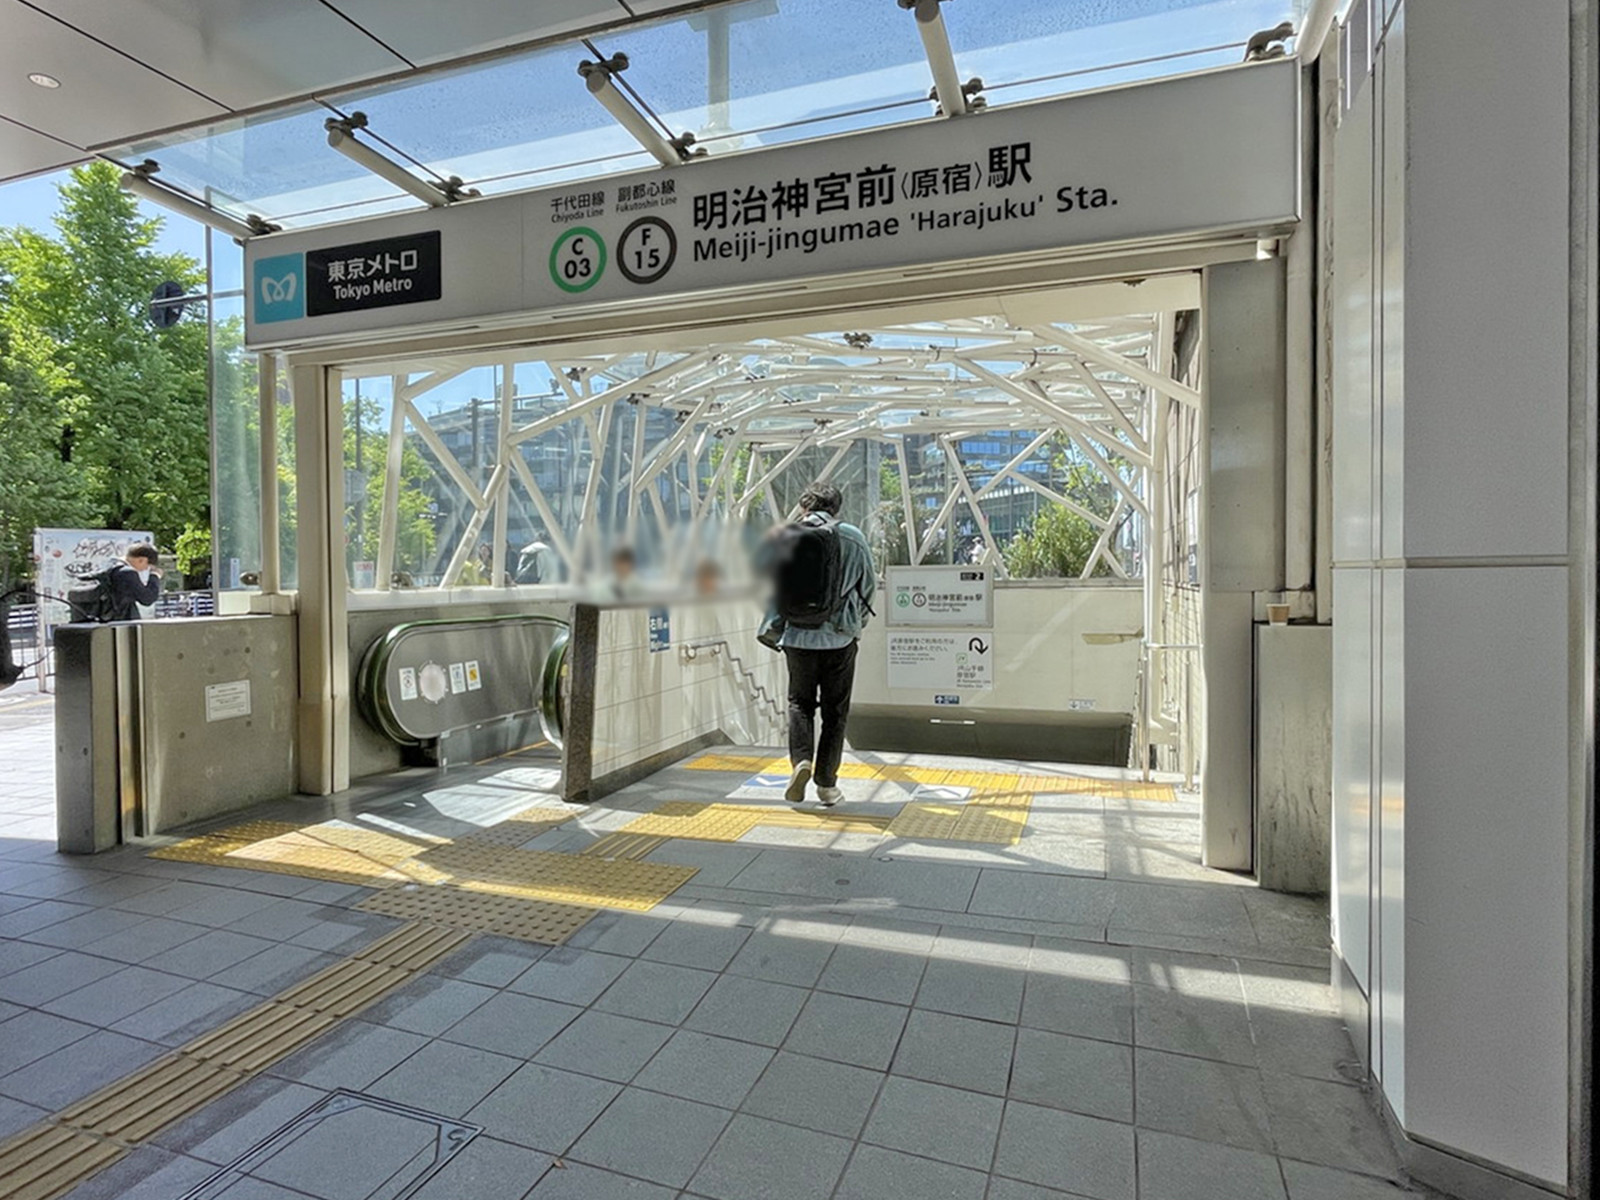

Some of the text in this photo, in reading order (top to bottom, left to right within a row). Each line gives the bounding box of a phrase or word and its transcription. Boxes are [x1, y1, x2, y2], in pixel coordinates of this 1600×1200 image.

[551, 190, 605, 212] 千代田線
[617, 179, 676, 202] 副都心線
[616, 196, 678, 213] Fukutoshin Line
[551, 208, 604, 224] Chiyoda Line
[693, 184, 1119, 262] Meiji-jingumae 'Harajuku' Sta.
[571, 237, 584, 256] C
[641, 228, 652, 246] F
[327, 249, 418, 284] 東京メトロ
[564, 257, 591, 279] 03
[634, 248, 660, 270] 15
[332, 277, 413, 301] Tokyo Metro
